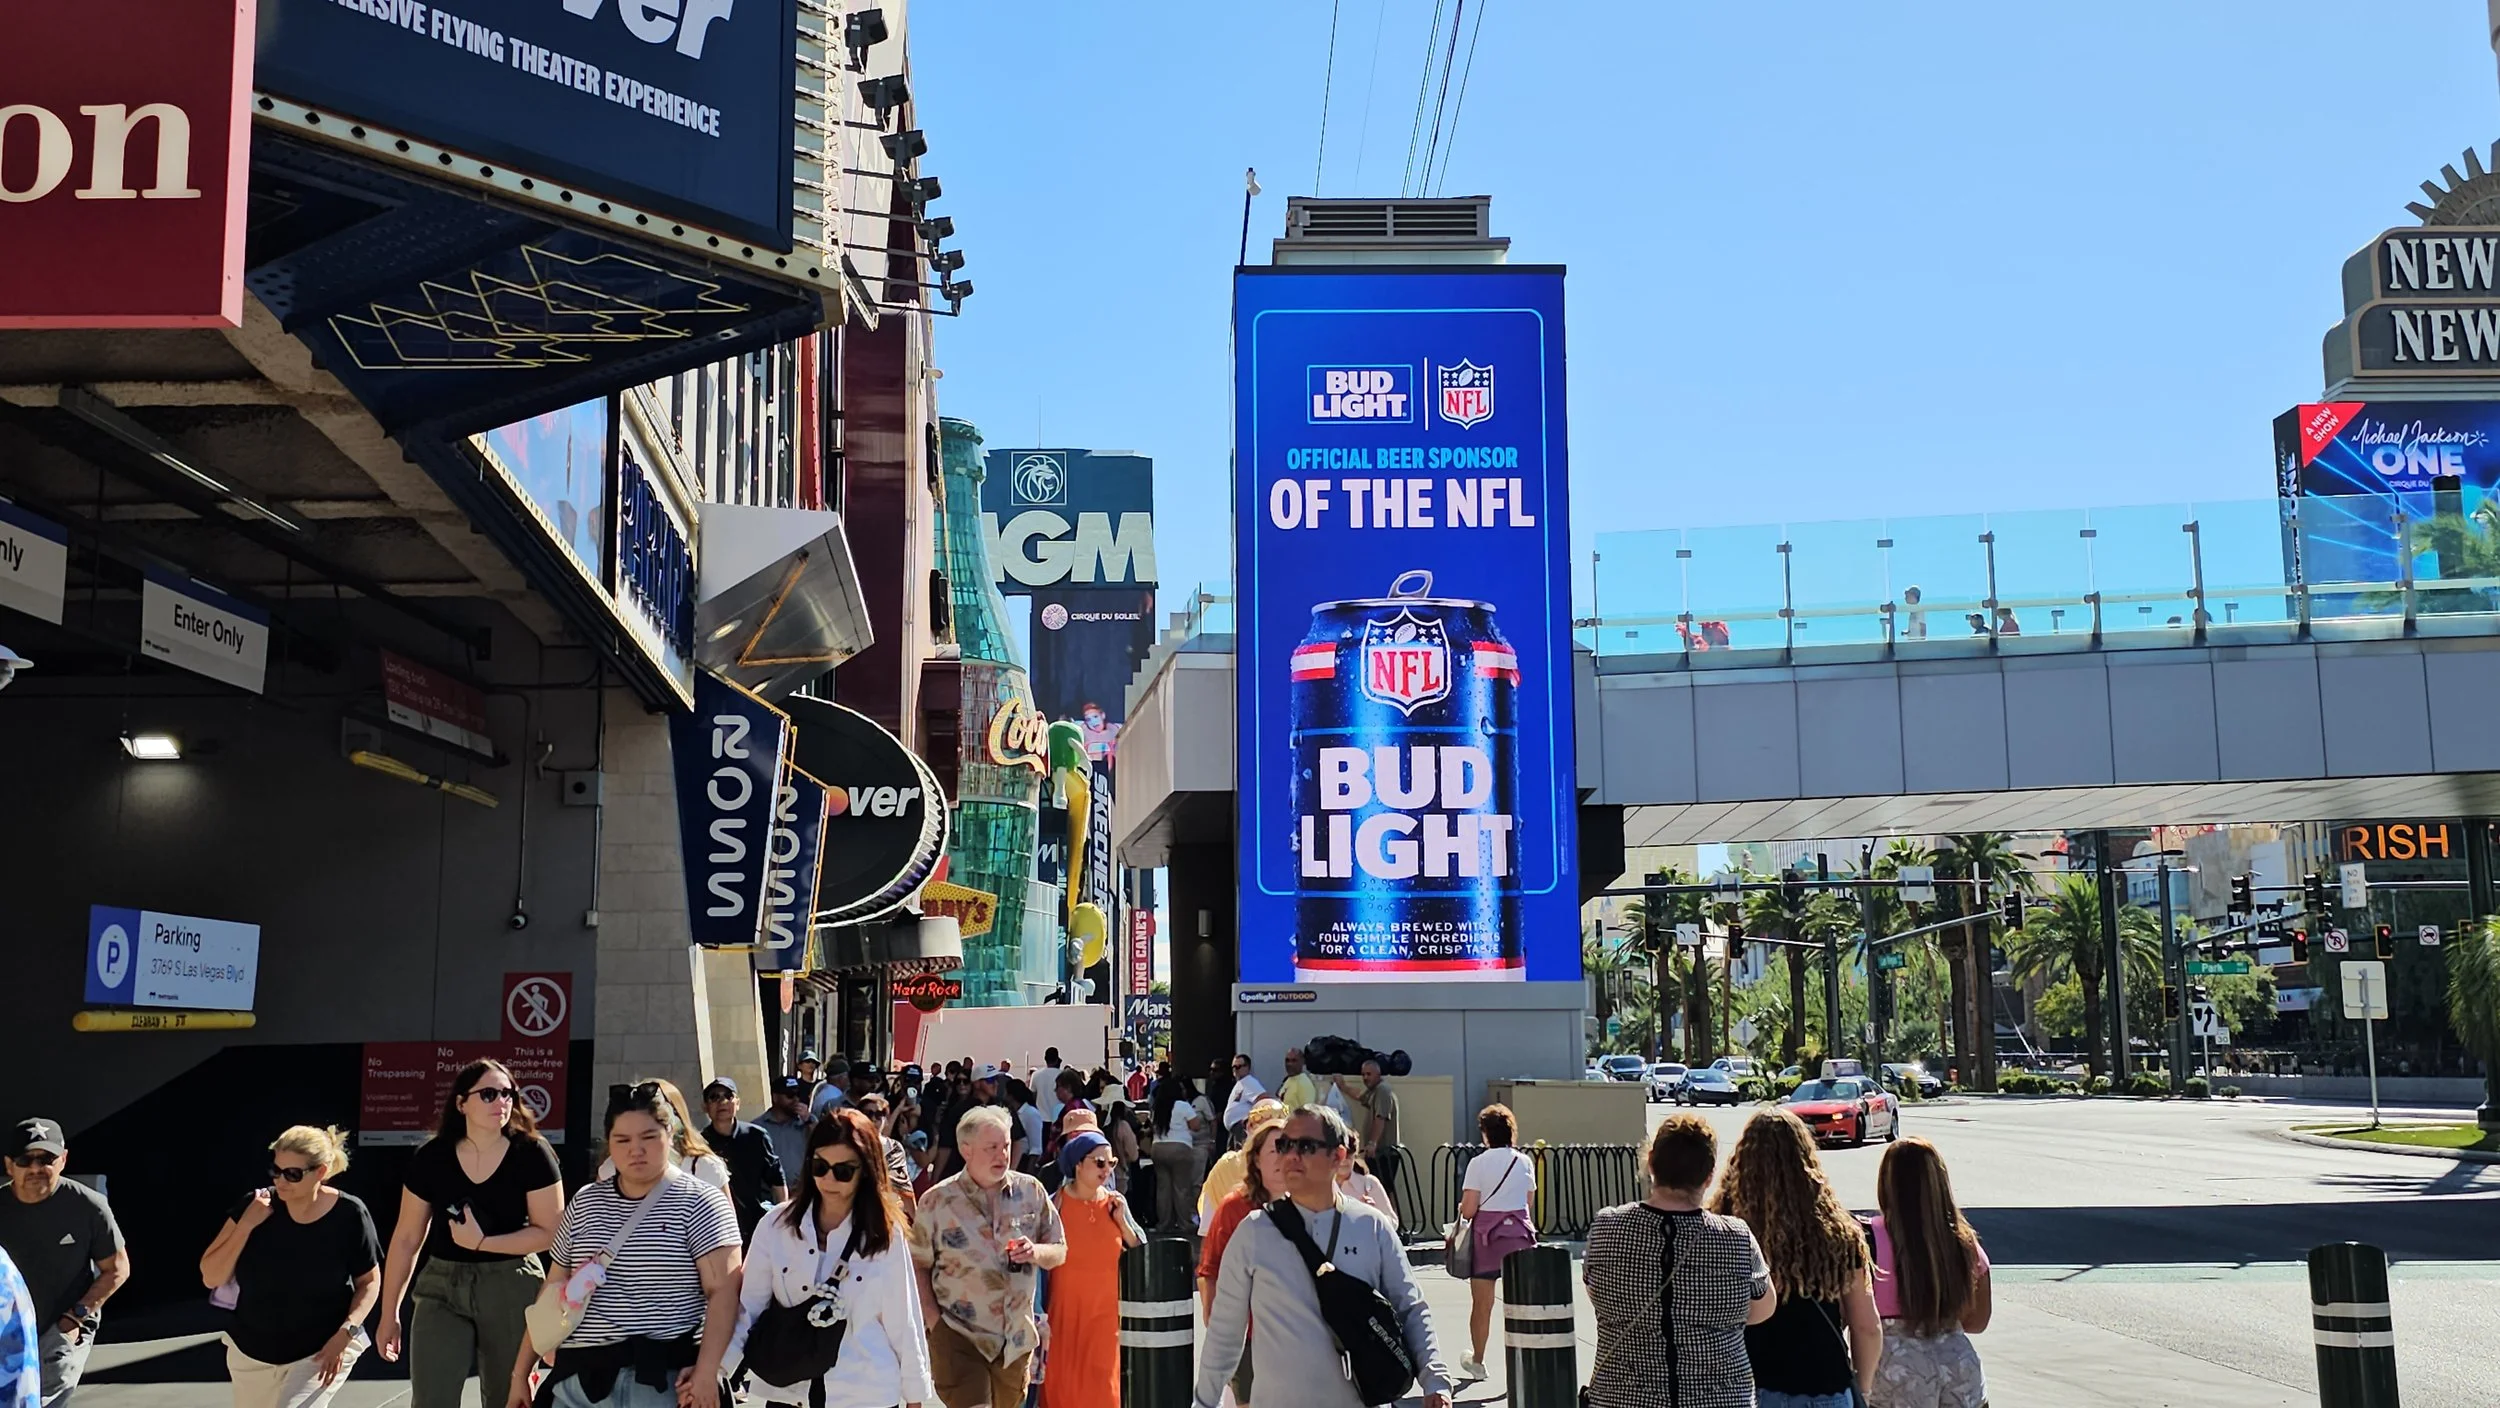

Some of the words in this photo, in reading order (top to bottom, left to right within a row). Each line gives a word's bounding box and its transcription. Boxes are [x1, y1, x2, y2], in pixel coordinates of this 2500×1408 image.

[430, 9, 505, 63] FLYING
[509, 36, 601, 97] THEATER
[604, 71, 721, 138] EXPERIENCE
[2386, 238, 2499, 291] NEW
[2391, 309, 2500, 362] NEW
[1326, 370, 1394, 394] BUD
[1313, 394, 1407, 419] LIGHT
[1445, 390, 1487, 417] NFL
[2305, 427, 2314, 436] A
[2311, 407, 2331, 428] NEW
[2313, 415, 2339, 442] SHOW
[2351, 418, 2408, 454] Michael
[2404, 420, 2478, 456] Jackson
[1287, 448, 1372, 470] OFFICIAL
[1377, 448, 1425, 469] BEER
[1428, 447, 1518, 469] SPONSOR
[2372, 445, 2466, 475] ONE
[2389, 481, 2417, 489] CIRQUE
[1270, 479, 1331, 530] OF
[1342, 479, 1434, 529] THE
[1447, 478, 1535, 528] NFL
[982, 510, 1158, 586] GM
[174, 603, 210, 637] Enter
[213, 620, 244, 654] Only
[1071, 613, 1100, 622] CIRQUE
[1373, 651, 1442, 697] NFL
[1320, 746, 1493, 810] BUD
[706, 714, 753, 917] ROSS
[1094, 771, 1109, 913] SKECHER
[1301, 813, 1513, 879] LIGHT
[764, 786, 801, 950] ROSS
[155, 923, 201, 953] Parking
[1135, 911, 1148, 958] CANE'S
[1319, 933, 1350, 943] FOUR
[1354, 933, 1409, 943] SIMPLE
[1332, 922, 1385, 932] ALWAYS
[1390, 922, 1453, 932] BREWED
[106, 941, 120, 973] P
[1320, 945, 1343, 954] FOR
[1346, 945, 1356, 955] A
[1360, 945, 1413, 959] CLEAN,
[1418, 945, 1463, 955] CRISP
[151, 958, 173, 975] 3769
[174, 960, 181, 976] S
[183, 962, 198, 978] Las
[200, 963, 225, 982] Vegas
[2202, 963, 2223, 973] Park
[892, 981, 926, 996] Hard
[928, 981, 960, 999] Rock
[1240, 993, 1276, 1002] Spotlight
[368, 1057, 382, 1066] No
[437, 1047, 454, 1057] No
[506, 1059, 563, 1068] Smoke-free
[514, 1046, 534, 1055] This
[537, 1047, 545, 1055] is
[368, 1069, 425, 1080] Trespassing
[514, 1070, 554, 1080] Building
